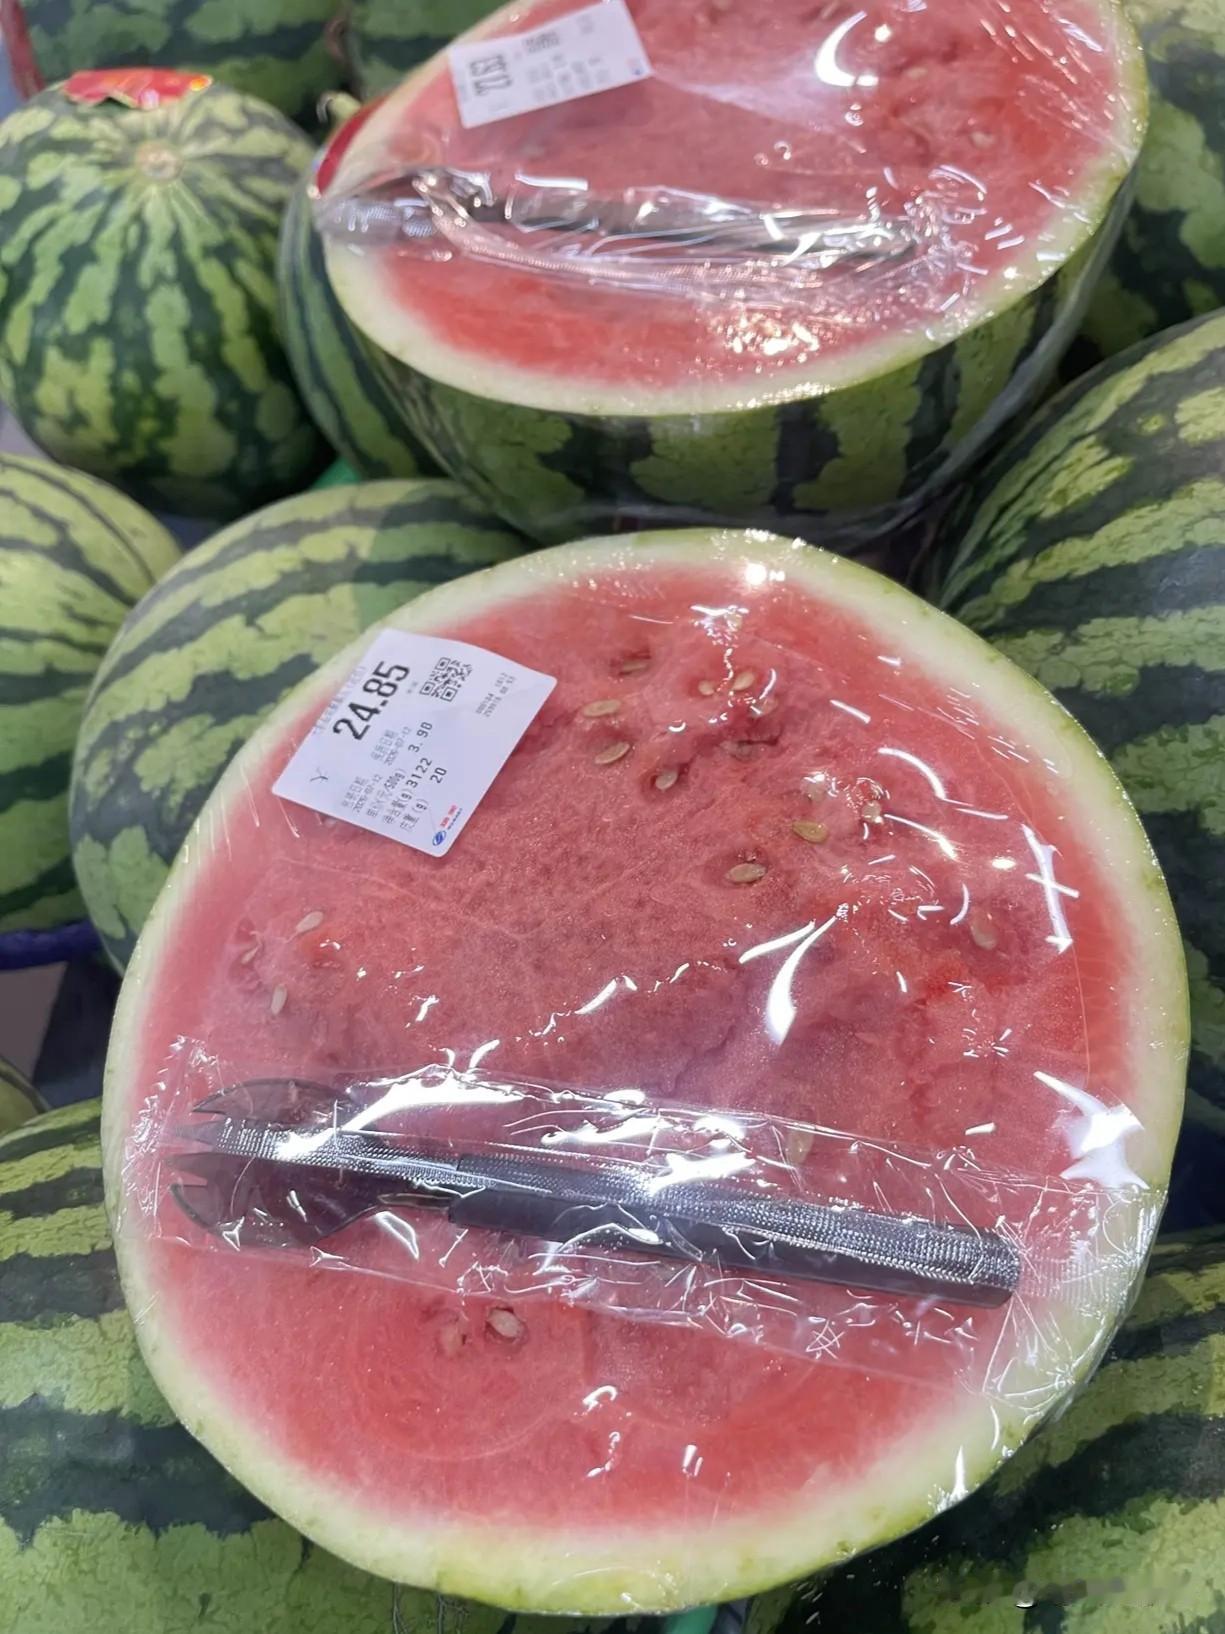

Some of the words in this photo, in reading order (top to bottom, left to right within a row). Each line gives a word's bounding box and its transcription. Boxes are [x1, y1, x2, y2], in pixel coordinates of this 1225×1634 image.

[333, 661, 410, 740] 24.85
[405, 758, 432, 788] 3122
[430, 767, 447, 783] 20
